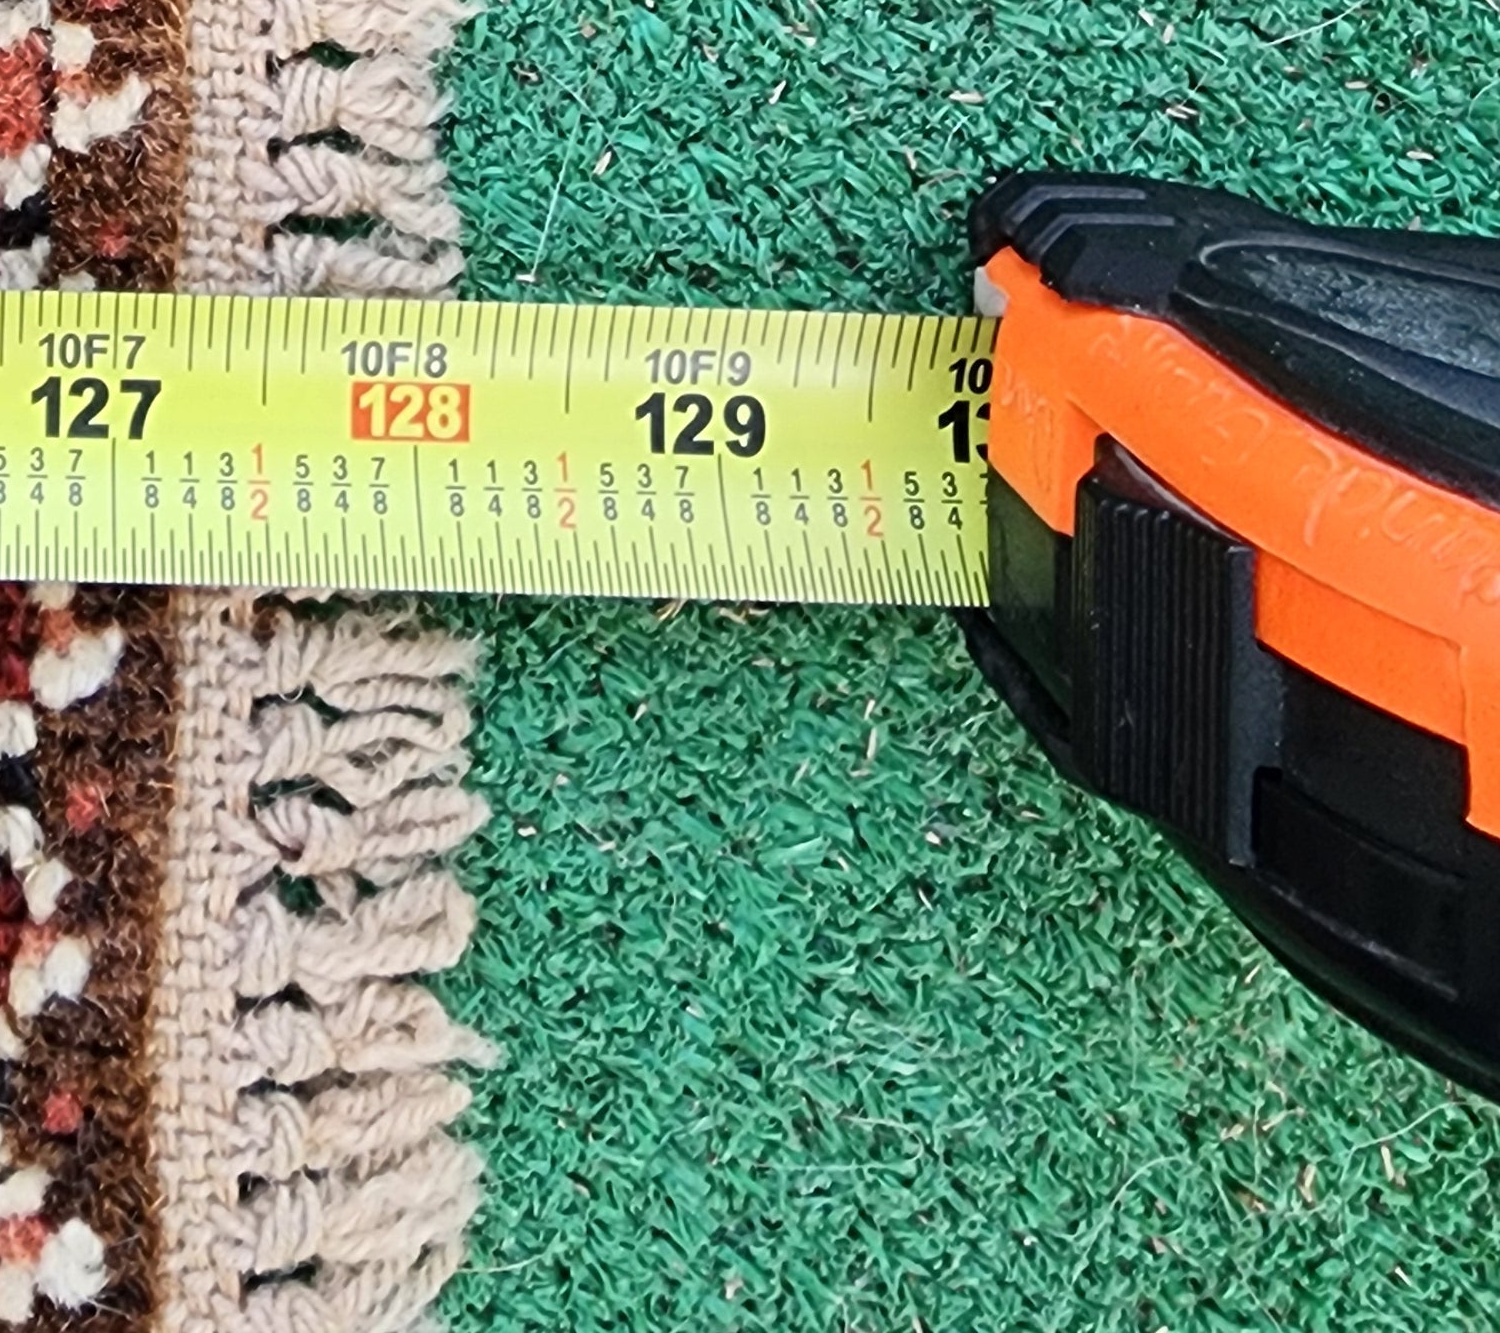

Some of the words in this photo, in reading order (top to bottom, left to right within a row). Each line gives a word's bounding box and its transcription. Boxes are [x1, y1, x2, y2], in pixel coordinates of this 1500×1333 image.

[30, 377, 161, 440] 127
[357, 384, 462, 439] 128
[634, 393, 767, 456] 129
